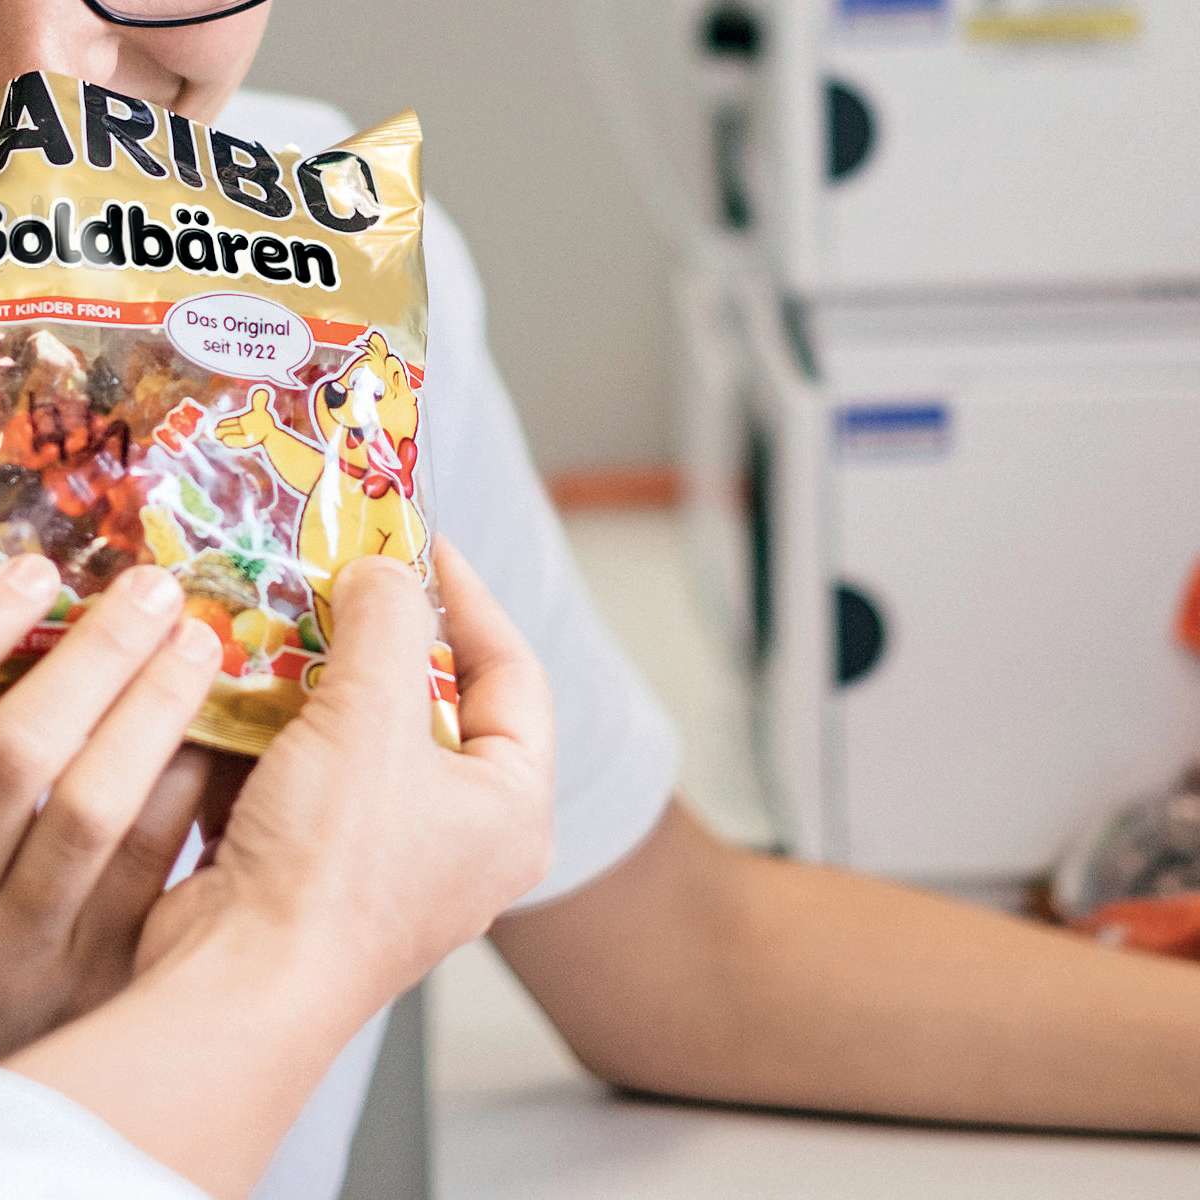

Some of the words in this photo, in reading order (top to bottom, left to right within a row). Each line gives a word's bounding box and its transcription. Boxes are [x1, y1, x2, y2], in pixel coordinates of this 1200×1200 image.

[15, 301, 73, 317] KINDER
[77, 303, 121, 319] FROH
[186, 310, 218, 329] Das
[223, 315, 290, 338] Original
[203, 339, 231, 354] seit
[236, 341, 276, 360] 1922
